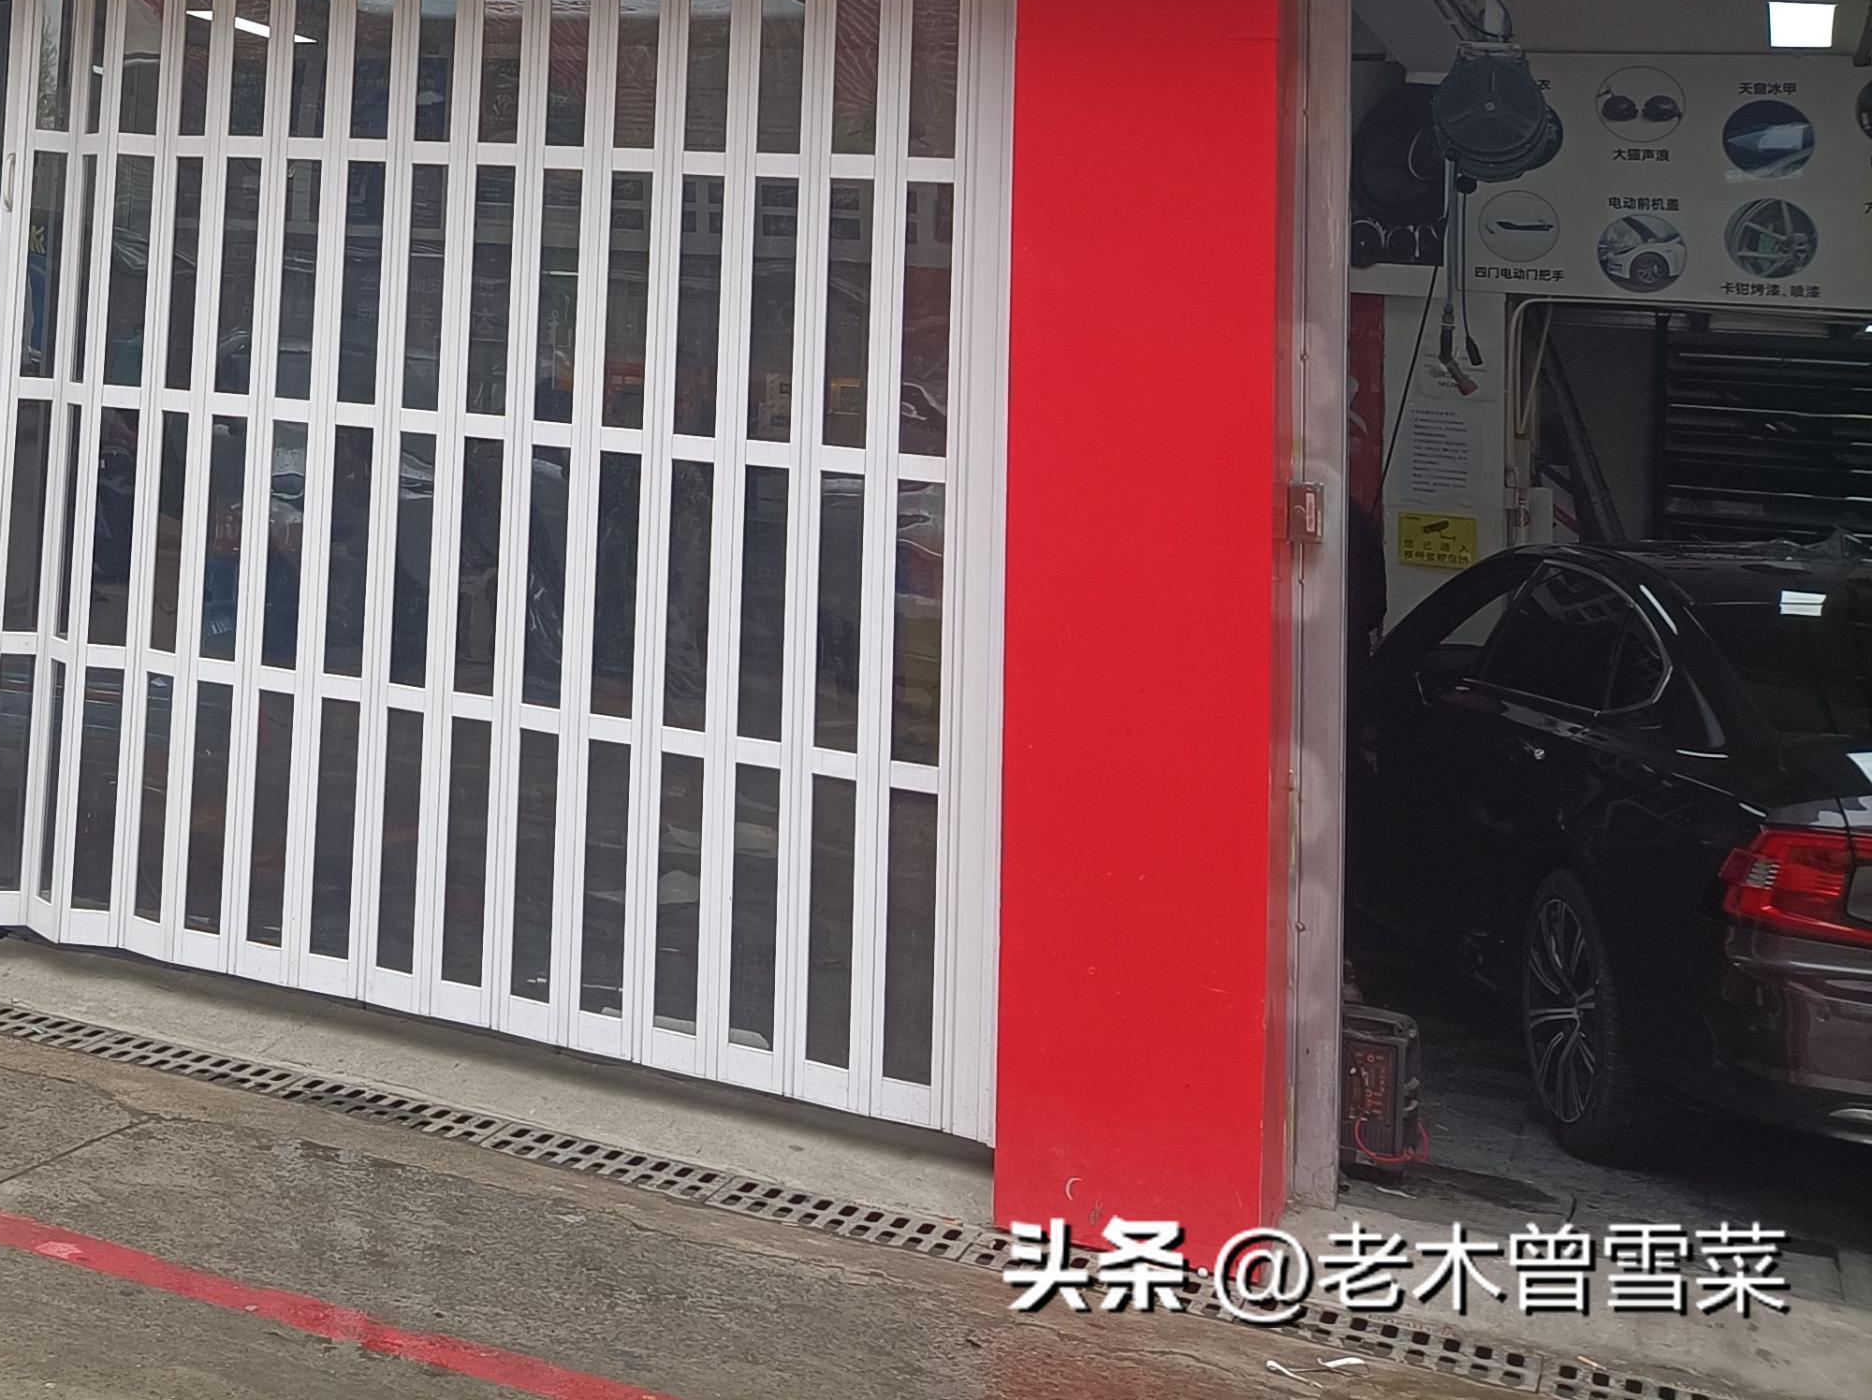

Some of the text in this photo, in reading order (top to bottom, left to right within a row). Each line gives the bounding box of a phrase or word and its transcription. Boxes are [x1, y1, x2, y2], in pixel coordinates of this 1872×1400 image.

[1474, 266, 1566, 282] 四门电动门把手
